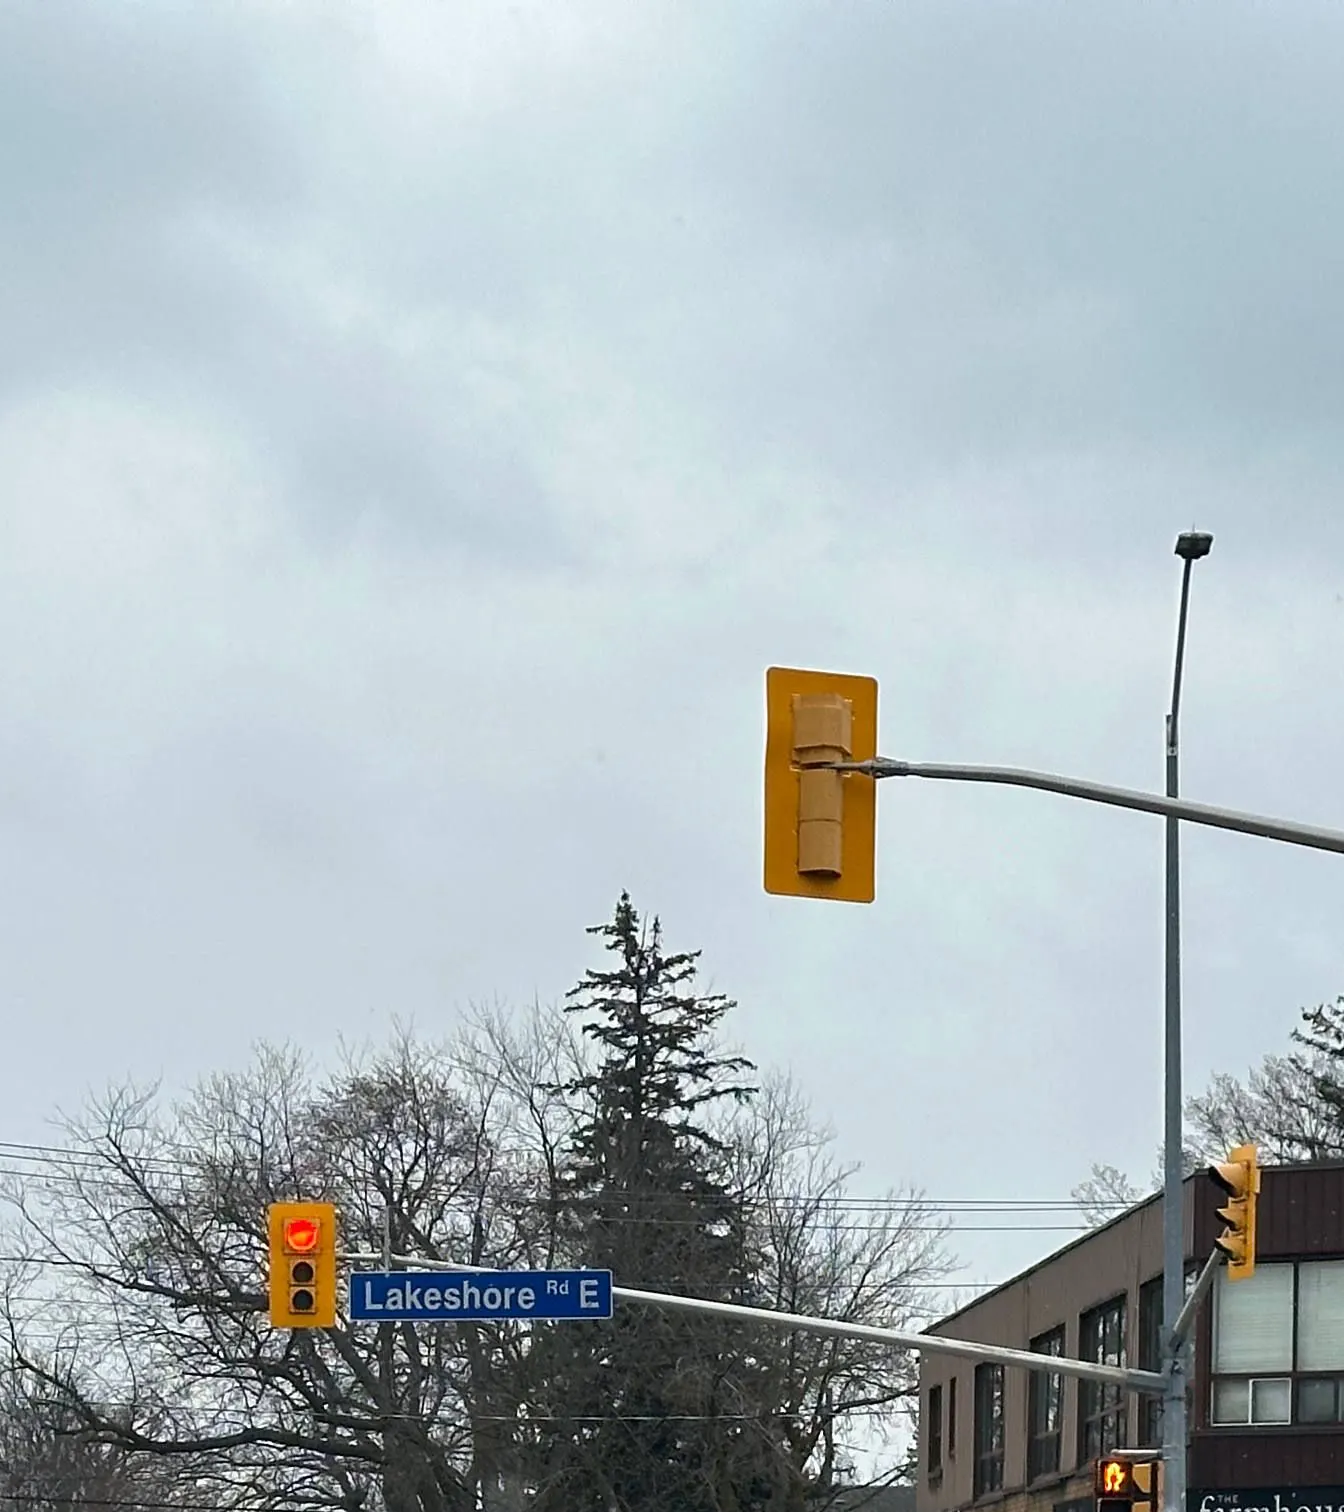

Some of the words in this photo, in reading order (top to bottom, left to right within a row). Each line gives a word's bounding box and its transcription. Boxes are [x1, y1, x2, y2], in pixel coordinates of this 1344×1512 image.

[364, 1280, 535, 1311] Lakeshore
[546, 1279, 569, 1295] Rd
[579, 1279, 600, 1309] E
[1217, 1493, 1239, 1504] THE
